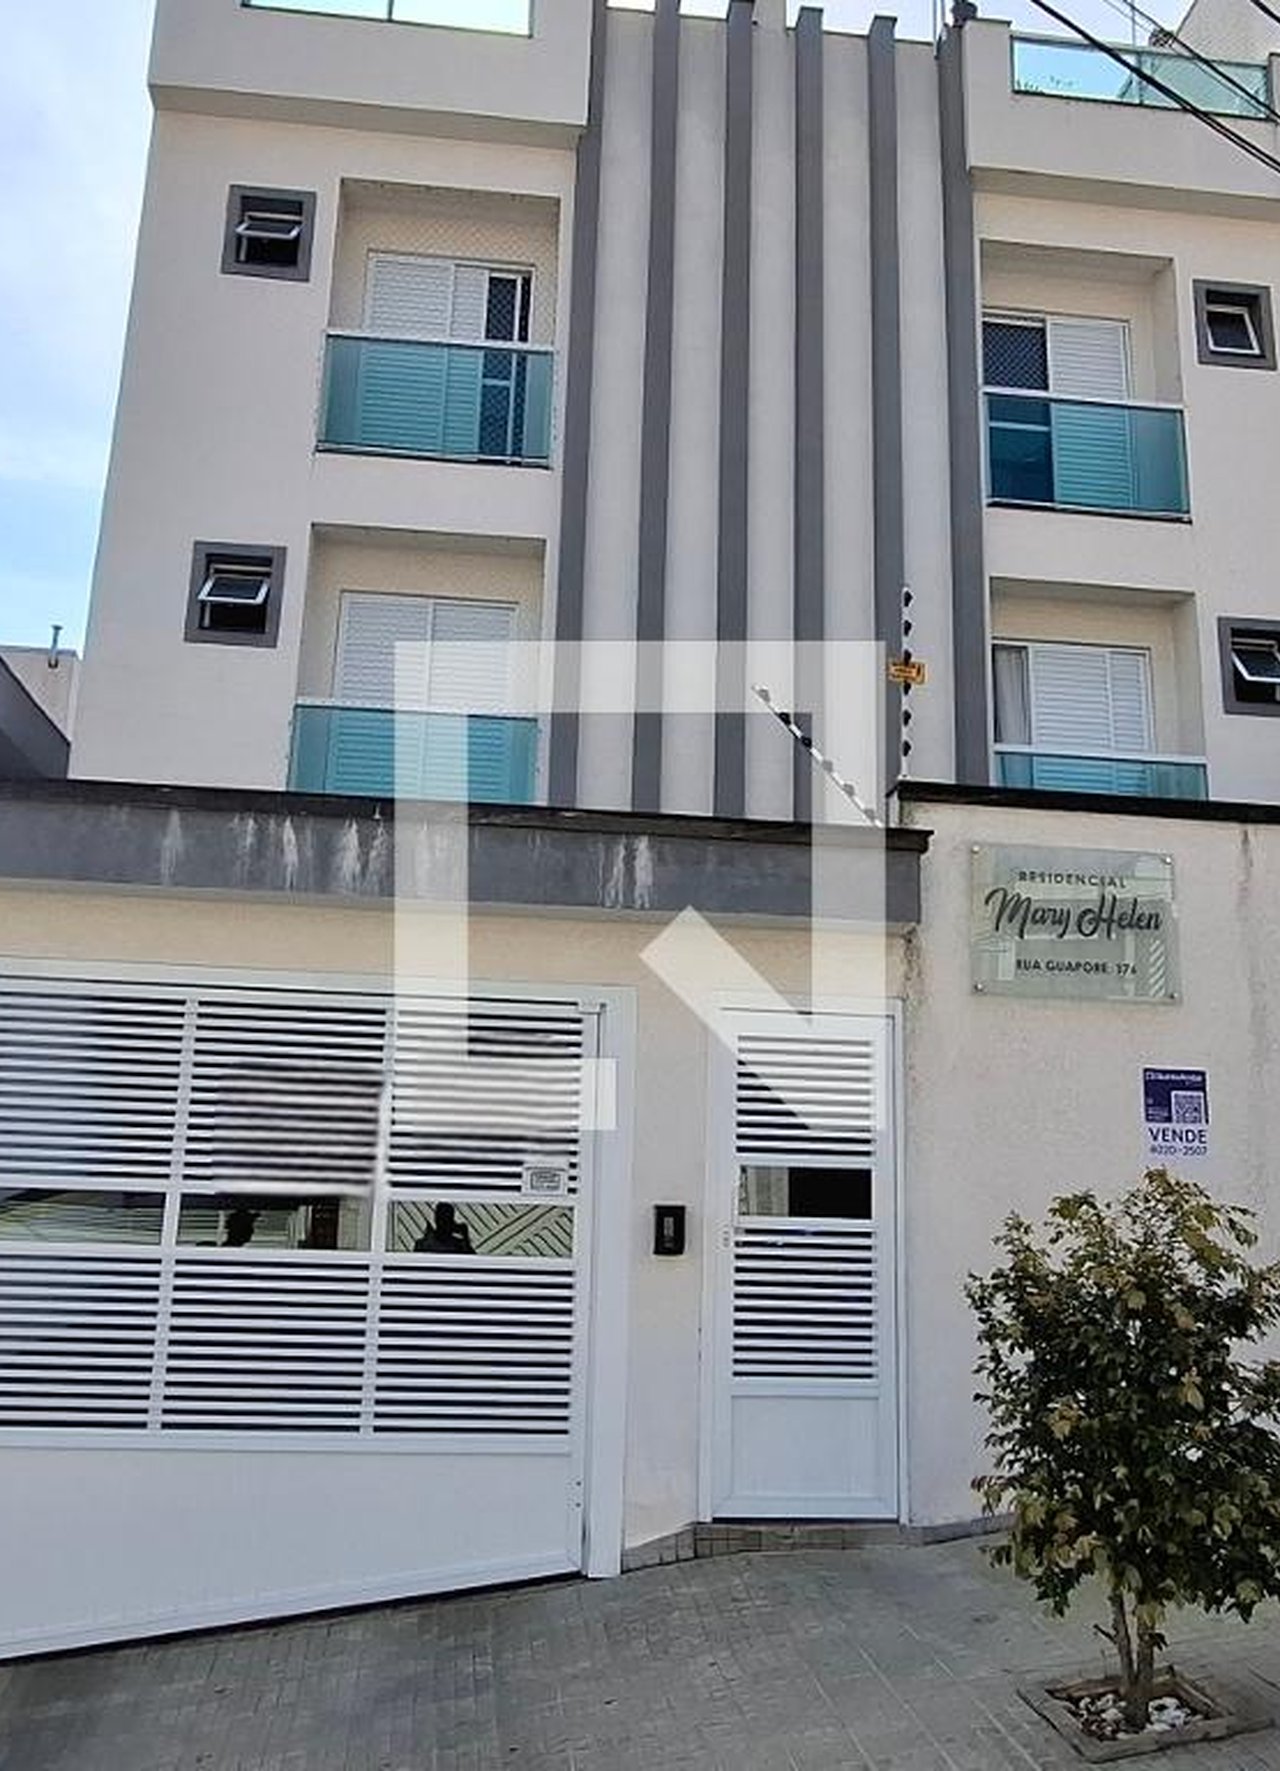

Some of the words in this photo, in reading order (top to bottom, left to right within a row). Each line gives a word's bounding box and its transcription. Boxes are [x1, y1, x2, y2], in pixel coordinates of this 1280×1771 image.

[1019, 870, 1127, 889] RESIDENCIAL
[984, 887, 1071, 940] Mary
[1076, 893, 1162, 941] Helen
[1016, 958, 1042, 972] RUA
[1148, 1126, 1208, 1145] VENDE
